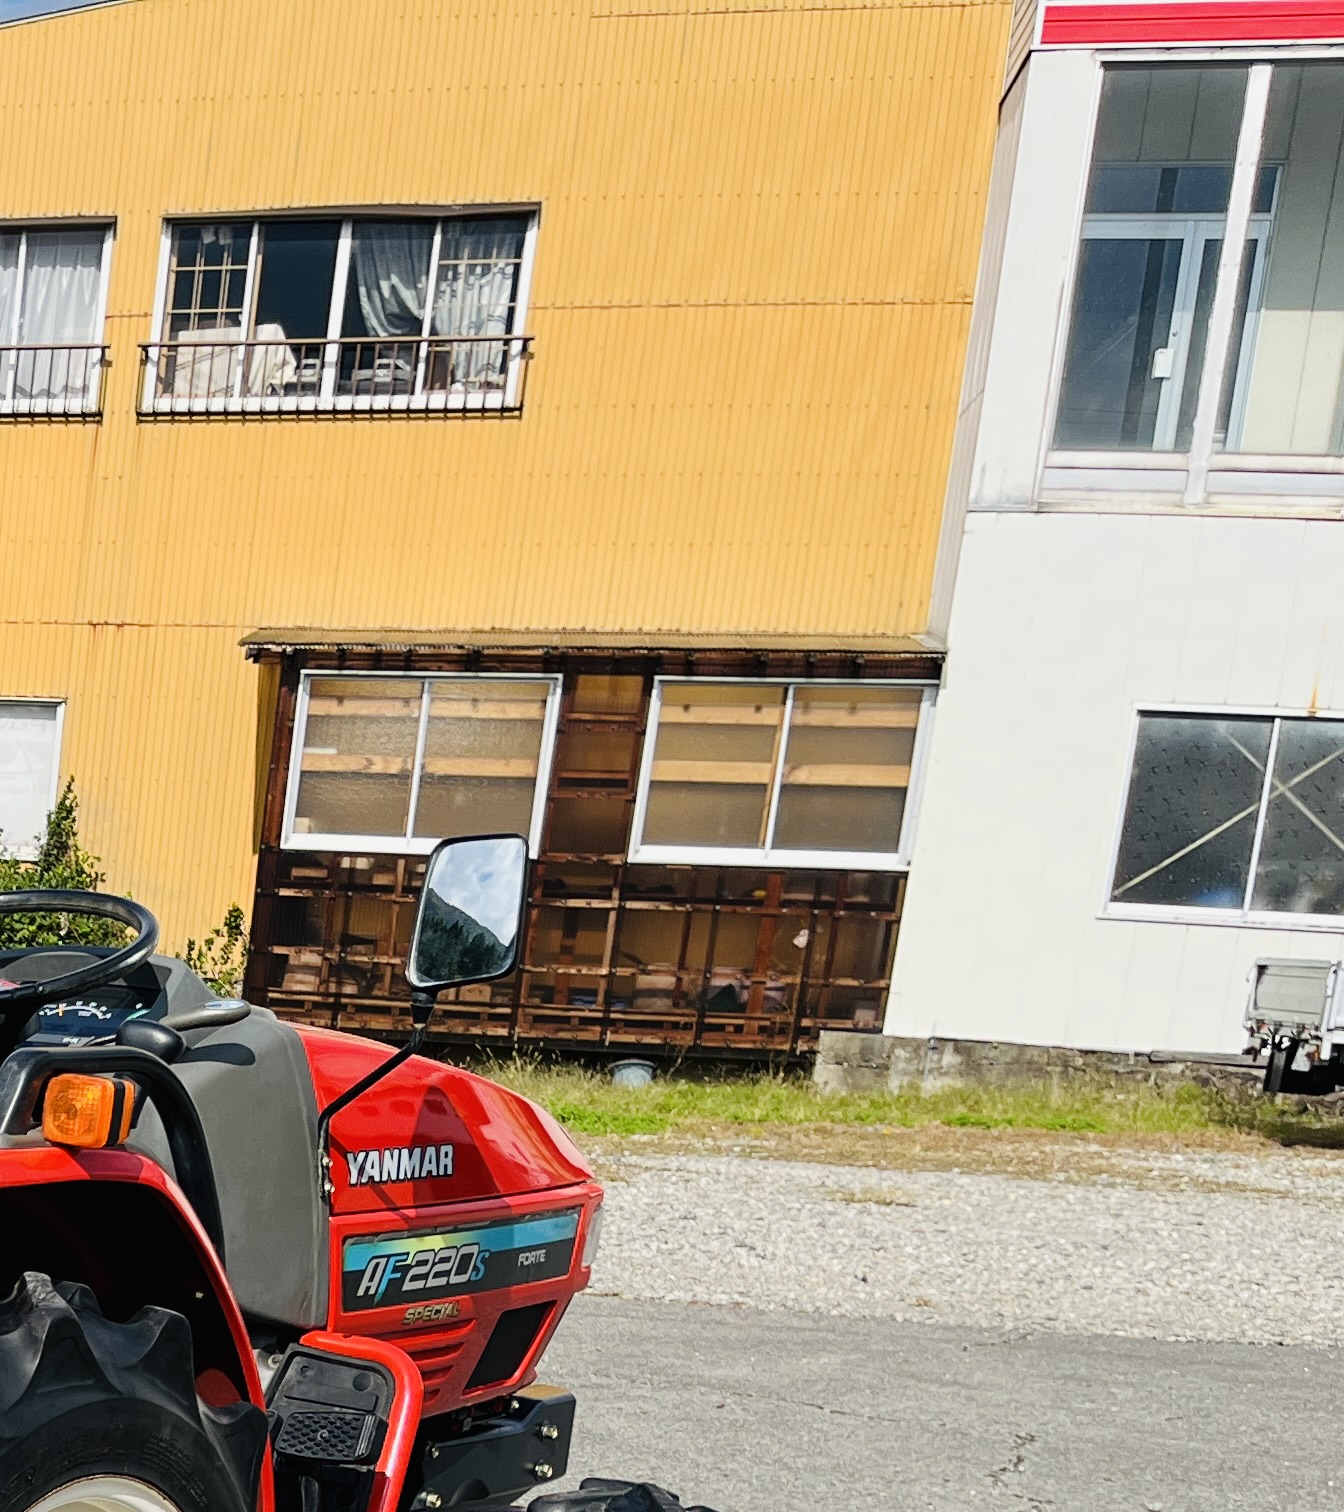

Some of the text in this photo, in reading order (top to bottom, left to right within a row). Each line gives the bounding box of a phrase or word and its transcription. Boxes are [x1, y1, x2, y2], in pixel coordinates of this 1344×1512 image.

[346, 1144, 454, 1185] YANMAR
[517, 1249, 547, 1267] FORTE
[401, 1302, 461, 1325] SPECIAL
